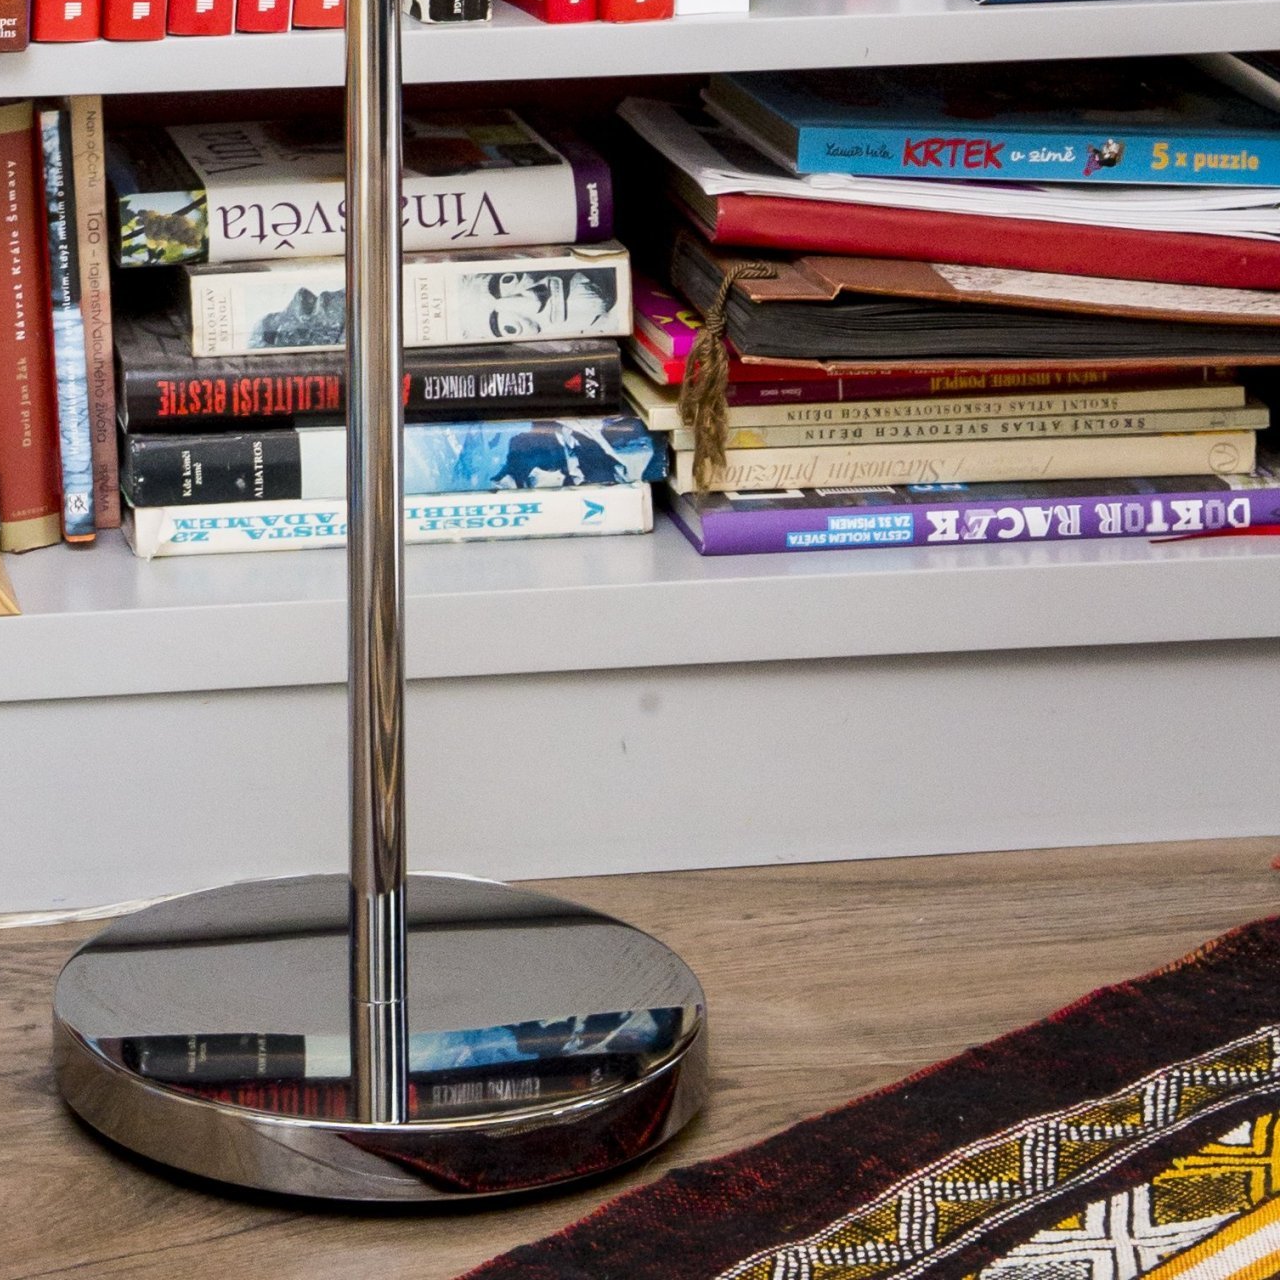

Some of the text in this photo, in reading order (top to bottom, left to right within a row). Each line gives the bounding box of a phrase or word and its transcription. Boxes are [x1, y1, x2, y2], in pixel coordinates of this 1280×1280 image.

[902, 137, 1006, 170] KRTEK
[1028, 147, 1076, 164] zimě
[1151, 143, 1169, 170] 5
[1193, 149, 1260, 172] puzzle
[1094, 497, 1252, 541] DOKTOR
